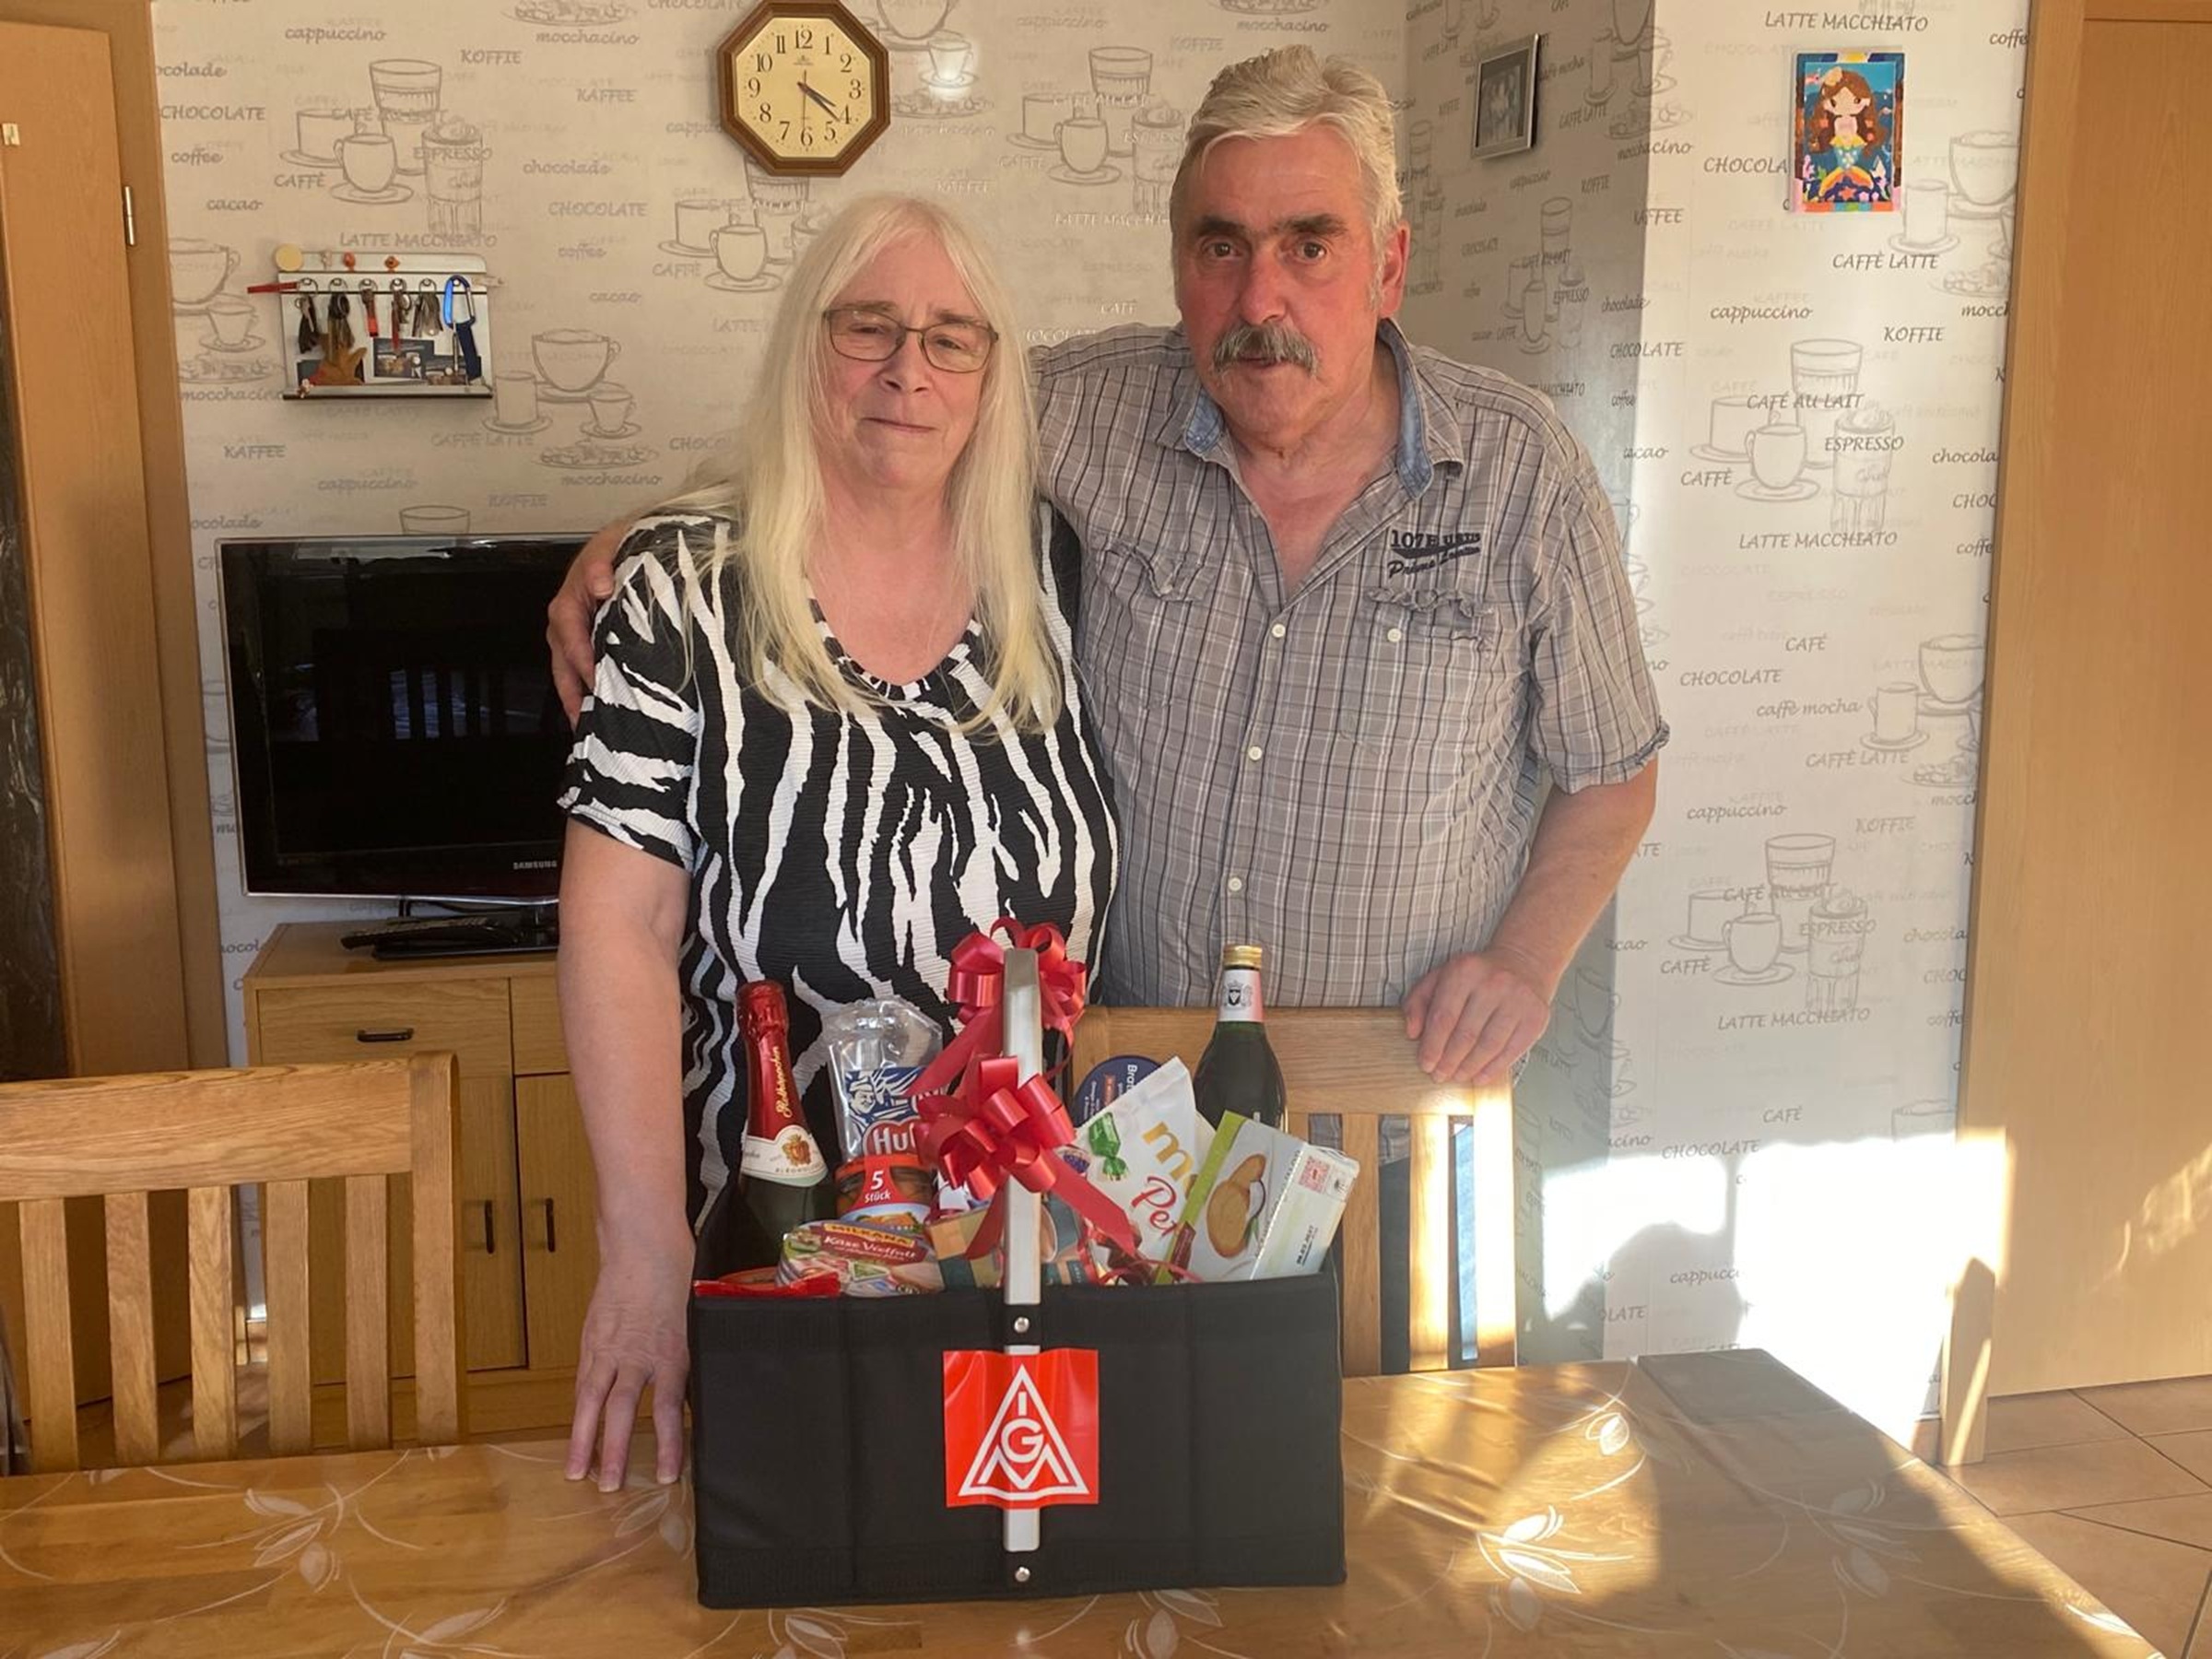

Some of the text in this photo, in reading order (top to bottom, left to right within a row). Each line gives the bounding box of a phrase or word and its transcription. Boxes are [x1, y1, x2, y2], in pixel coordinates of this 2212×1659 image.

[1236, 18, 1328, 32] mocchacino
[1764, 11, 1929, 32] LATTE MACCHIATO
[284, 27, 388, 45] cappuccino
[535, 29, 641, 46] mocchacino
[775, 35, 786, 54] 11
[794, 29, 814, 49] 12
[825, 36, 830, 55] 1
[461, 49, 523, 65] KOFFIE
[756, 53, 773, 73] 10
[840, 53, 853, 73] 2
[576, 88, 638, 103] KAFFEE
[747, 76, 761, 99] 9
[849, 79, 862, 100] 3
[160, 105, 265, 122] CHOCOLATE
[759, 102, 771, 124] 8
[840, 104, 852, 124] 4
[779, 121, 791, 141] 7
[800, 126, 813, 147] 6
[824, 121, 836, 141] 5
[171, 147, 224, 167] coffee
[413, 146, 493, 161] ESPRESSO
[523, 159, 612, 176] chocolade
[274, 173, 326, 189] CAFFÈ
[206, 198, 264, 212] cacao
[548, 202, 649, 218] CHOCOLATE
[339, 232, 498, 249] LATTE MACCHIATO
[558, 242, 606, 261] coffee
[1832, 251, 1939, 271] CAFFÈ LATTE
[588, 290, 643, 305] cacao
[1553, 287, 1590, 305] ESPRESSO
[1710, 304, 1813, 324] cappuccino
[1884, 326, 1946, 344] KOFFIE
[1610, 341, 1684, 359] CHOCOLATE
[1747, 391, 1865, 410] CAFÉ AU LAIT
[224, 443, 287, 459] KAFFEE
[1622, 447, 1669, 460] cacao
[1825, 436, 1904, 452] ESPRESSO
[560, 471, 662, 487] mocchacino
[1680, 467, 1734, 487] CAFFÈ
[1739, 532, 1898, 549] LATTE MACCHIATO
[1785, 632, 1828, 653] CAFÉ
[1679, 668, 1783, 688] CHOCOLATE
[1802, 697, 1863, 715] mocha
[1805, 749, 1911, 770] CAFFÈ LATTE
[1686, 804, 1788, 824] cappuccino
[1854, 816, 1917, 834] KOFFIE
[1723, 883, 1766, 902] CAFÉ
[1799, 919, 1877, 936] ESPRESSO
[1660, 955, 1712, 975] CAFFÈ
[1717, 1007, 1871, 1030] LATTE MACCHIATO
[1761, 1104, 1803, 1124] CAFÉ
[1661, 1138, 1761, 1160] CHOCOLATE
[870, 1169, 884, 1191] 5
[865, 1189, 892, 1205] Stück
